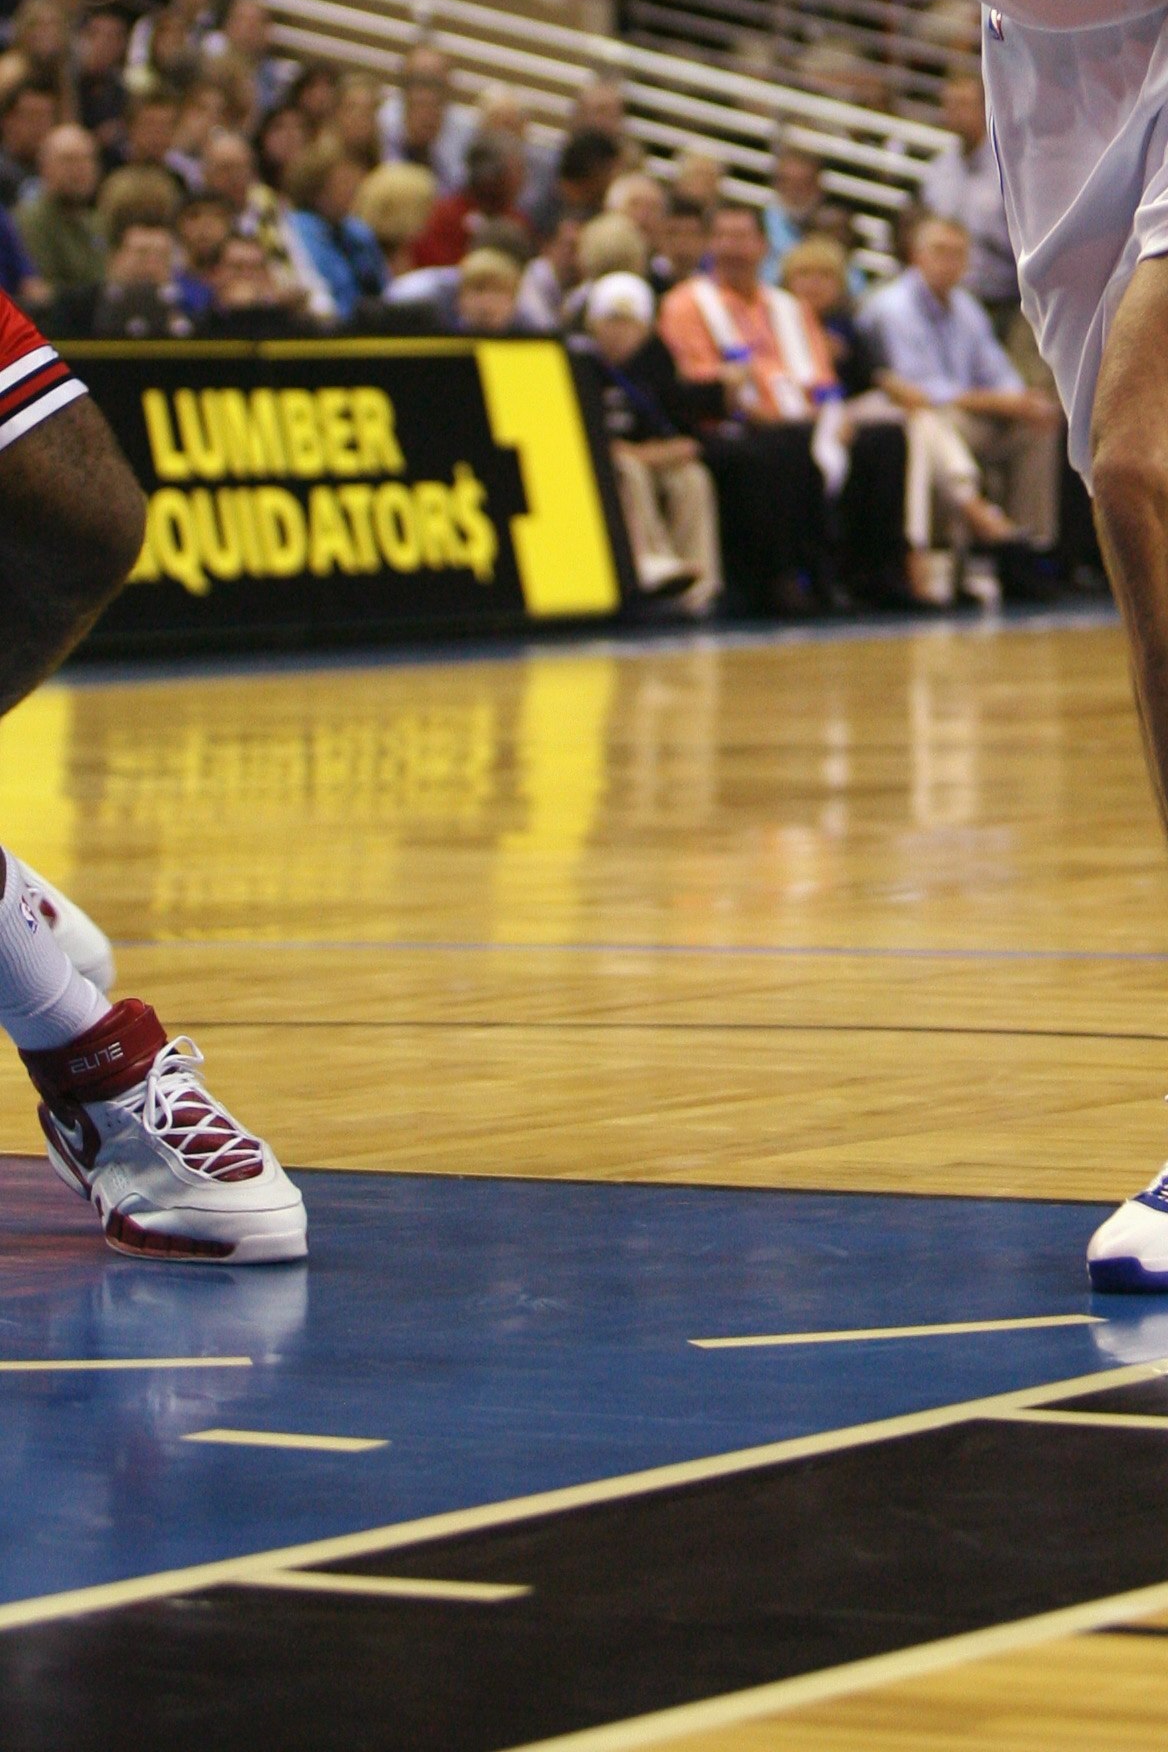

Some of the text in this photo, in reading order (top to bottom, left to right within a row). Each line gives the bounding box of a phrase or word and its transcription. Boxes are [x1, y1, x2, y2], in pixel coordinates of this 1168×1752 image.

[142, 386, 405, 480] LUMBER
[128, 462, 498, 595] QUIDATOR$
[69, 1041, 124, 1074] ELITE
